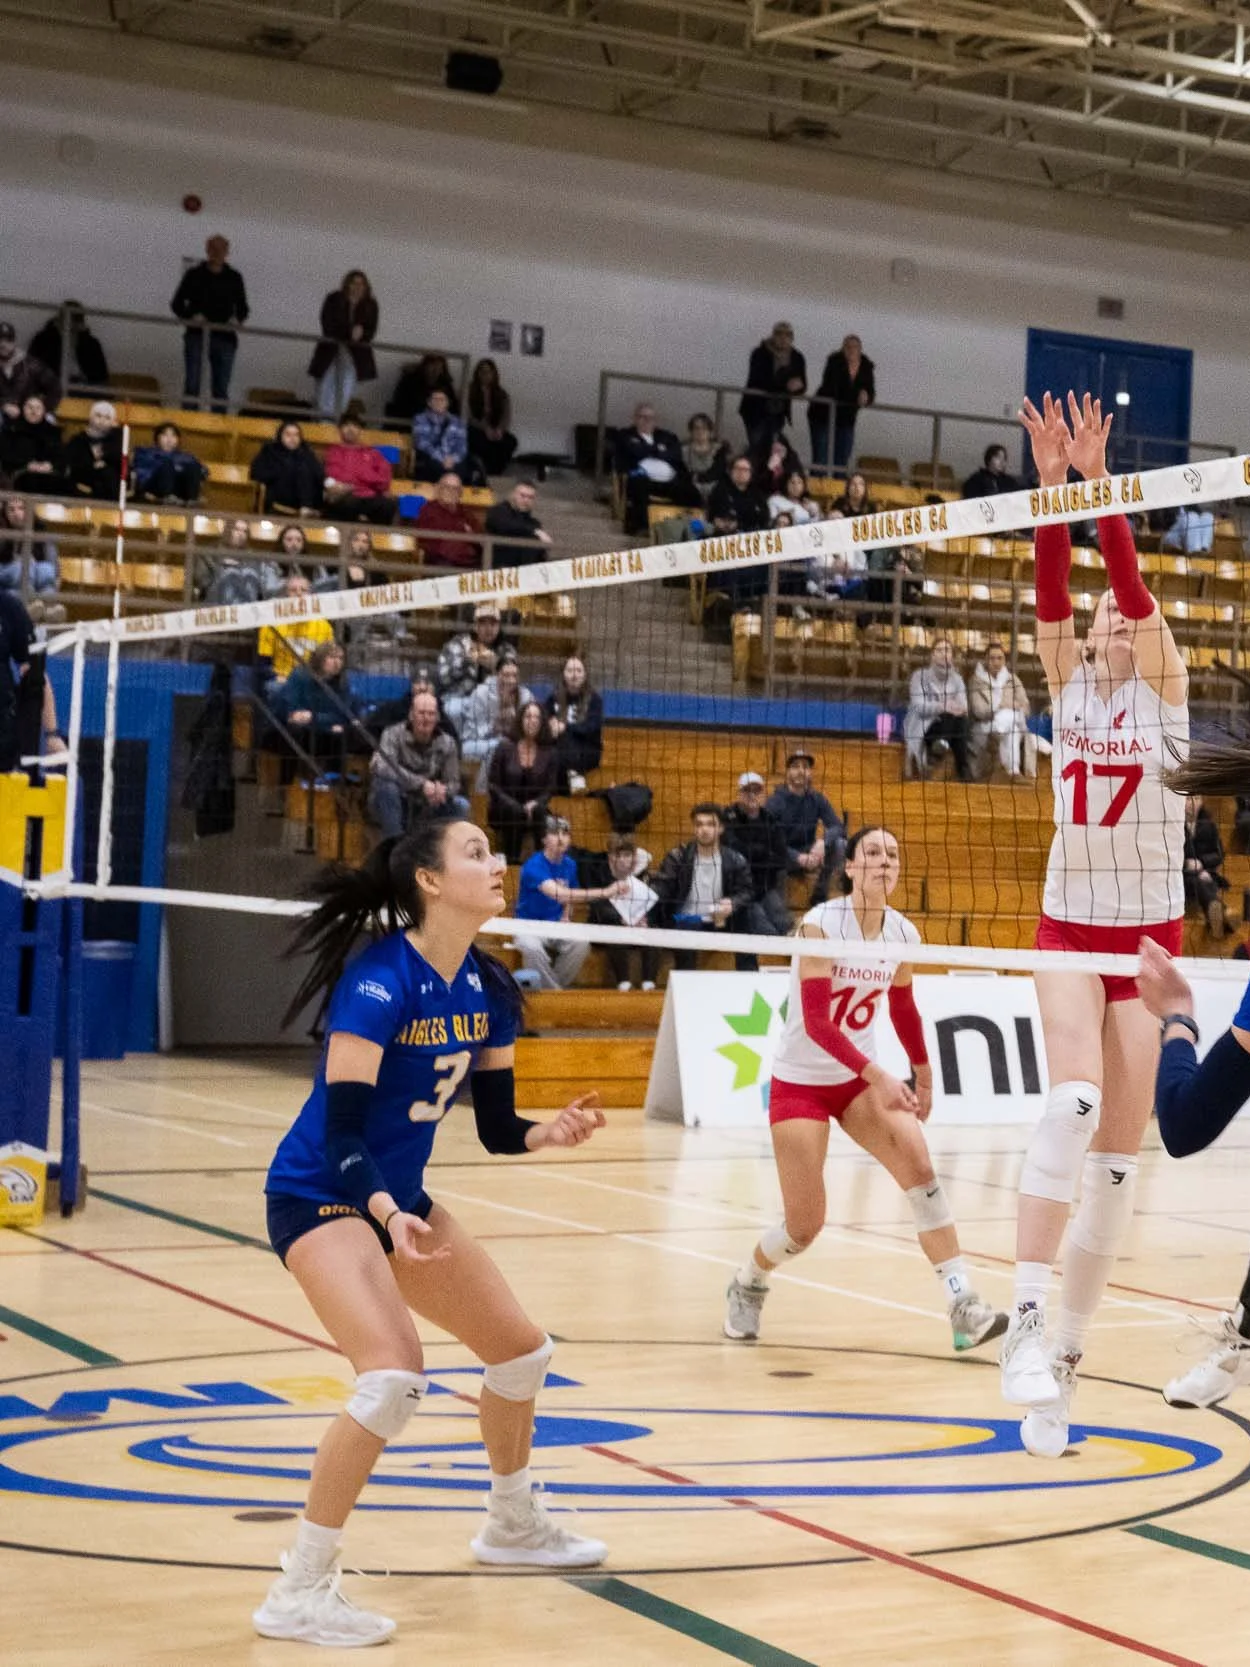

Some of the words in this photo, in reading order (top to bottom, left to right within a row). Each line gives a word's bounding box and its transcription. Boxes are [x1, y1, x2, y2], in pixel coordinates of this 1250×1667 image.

[1030, 476, 1144, 517] GOAIGLES.CA
[1060, 727, 1152, 756] MEMORIAL
[1061, 758, 1144, 828] 17
[831, 964, 892, 983] MEMORIA
[830, 986, 884, 1031] 16
[408, 1050, 472, 1123] 3
